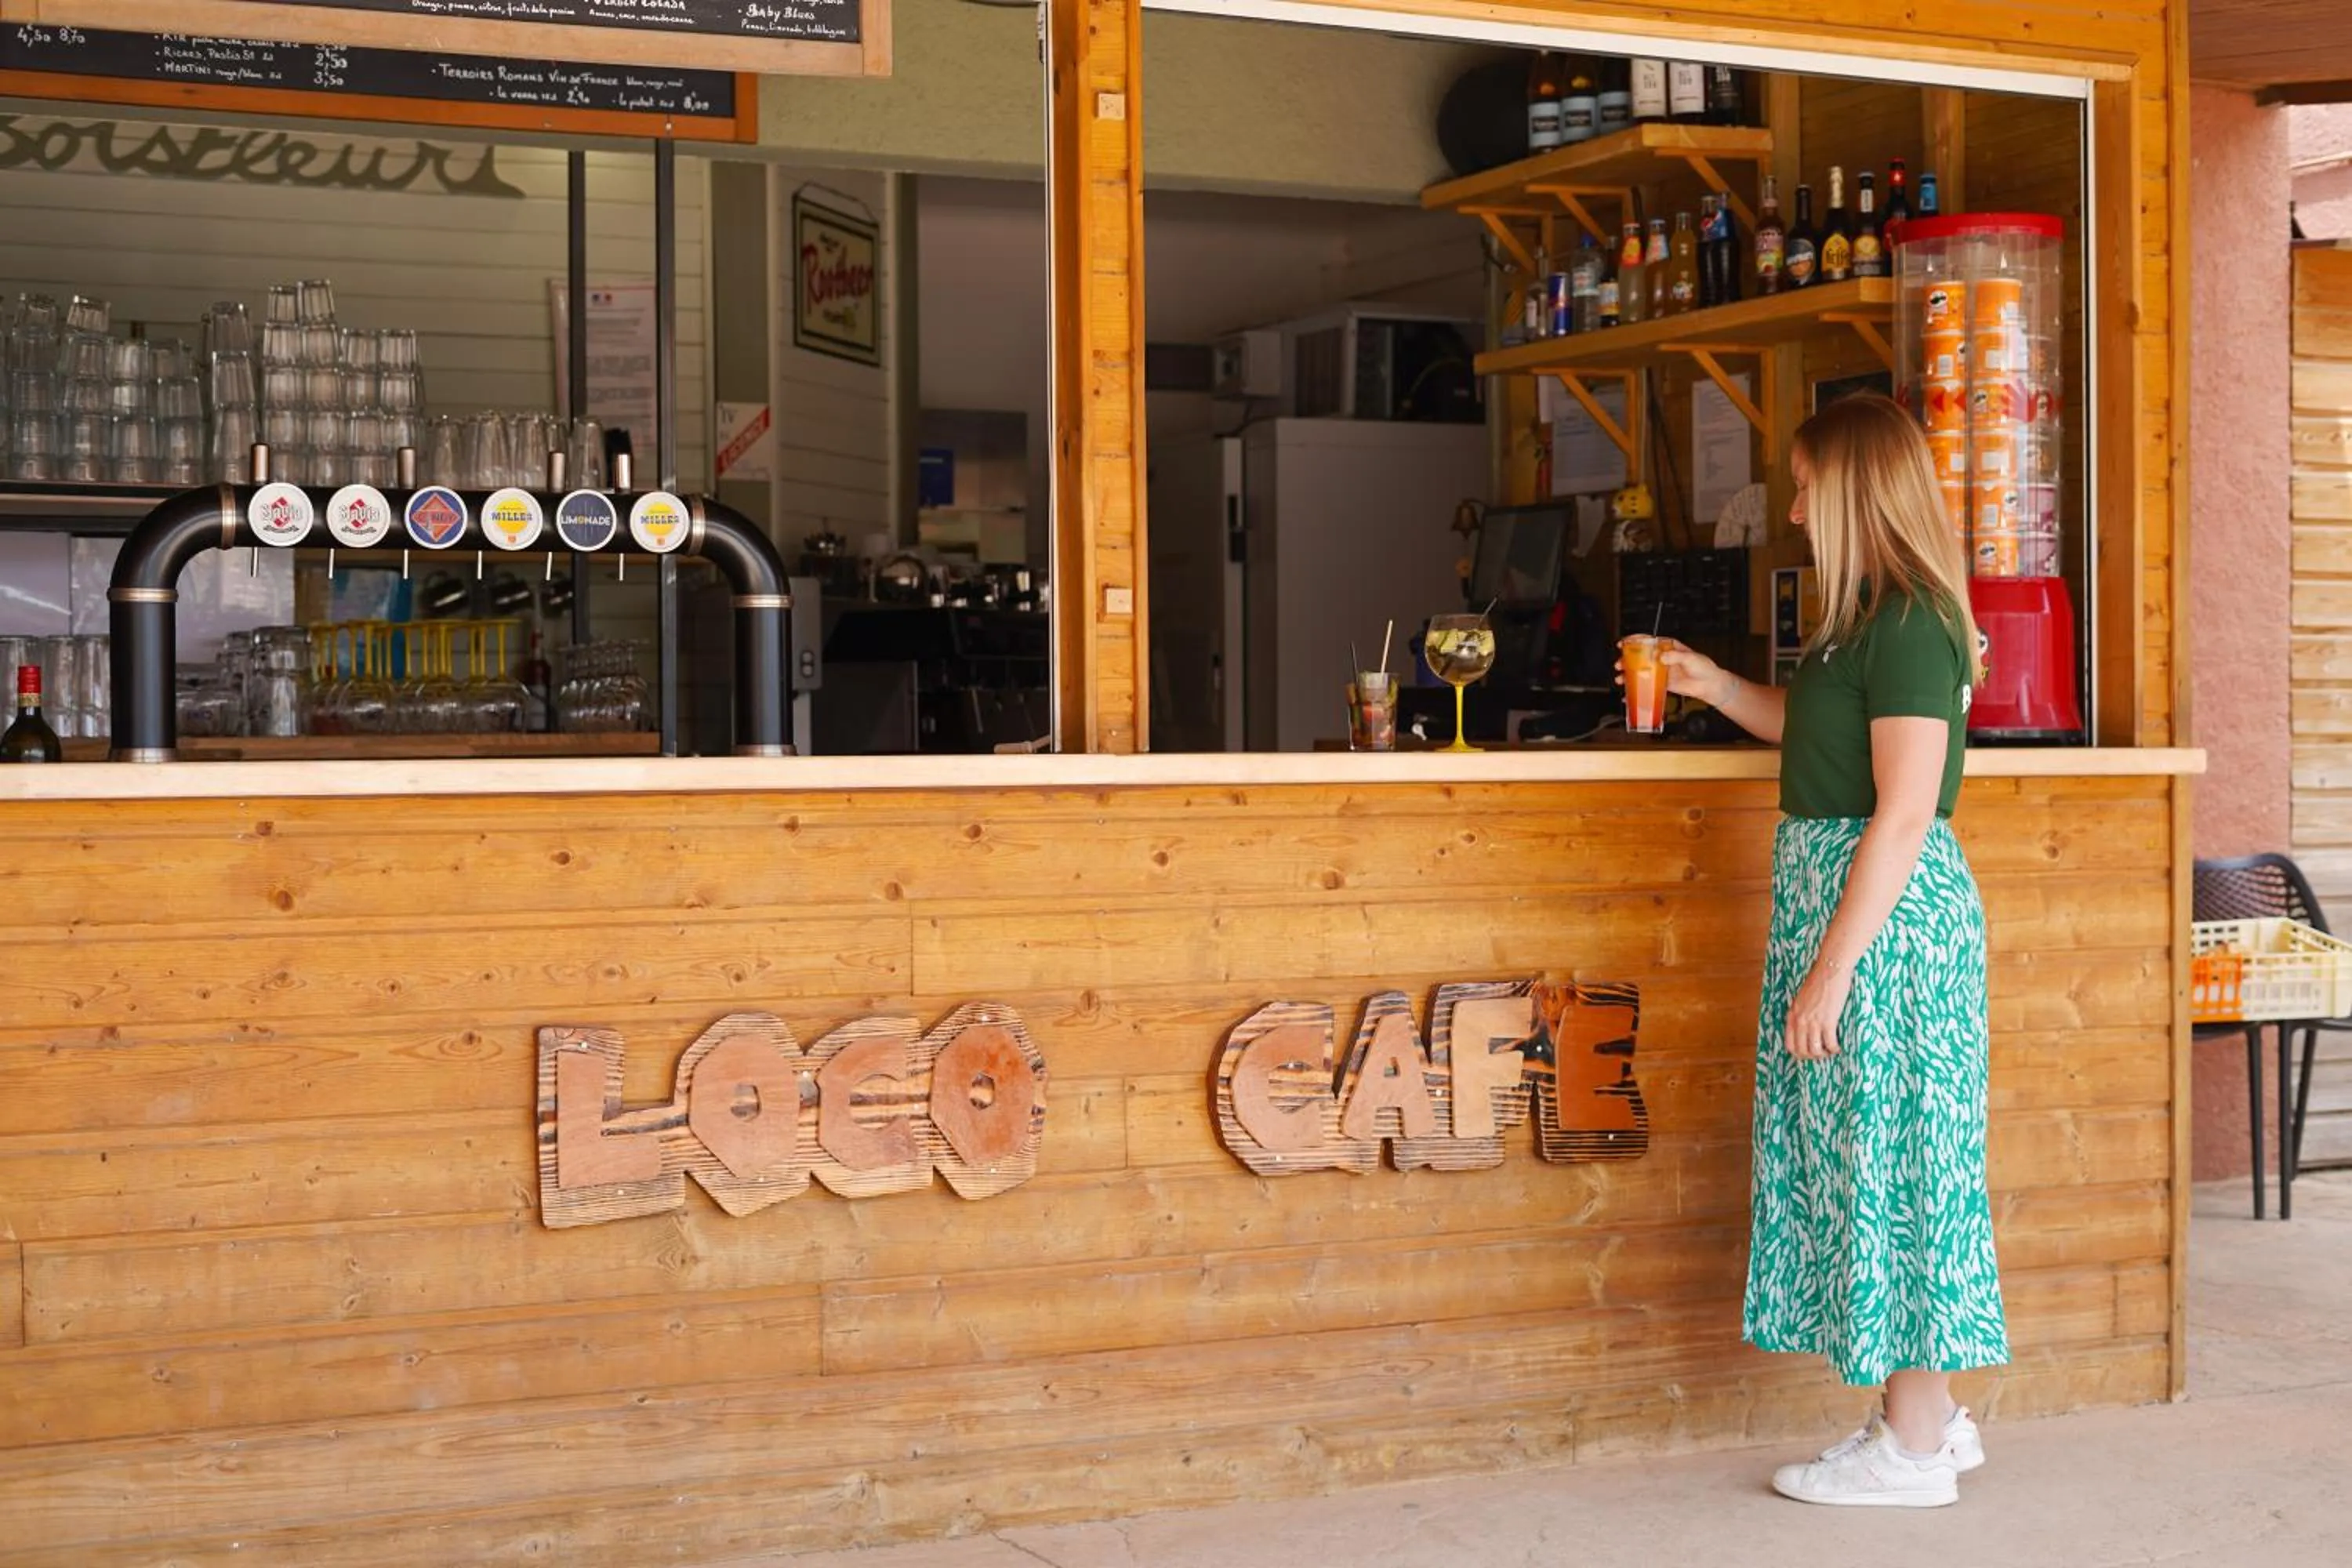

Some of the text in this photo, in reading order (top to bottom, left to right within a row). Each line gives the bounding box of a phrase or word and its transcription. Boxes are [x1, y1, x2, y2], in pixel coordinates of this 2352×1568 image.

[560, 514, 612, 527] LIMONADE
[554, 991, 1640, 1192] LOCO CAFE
